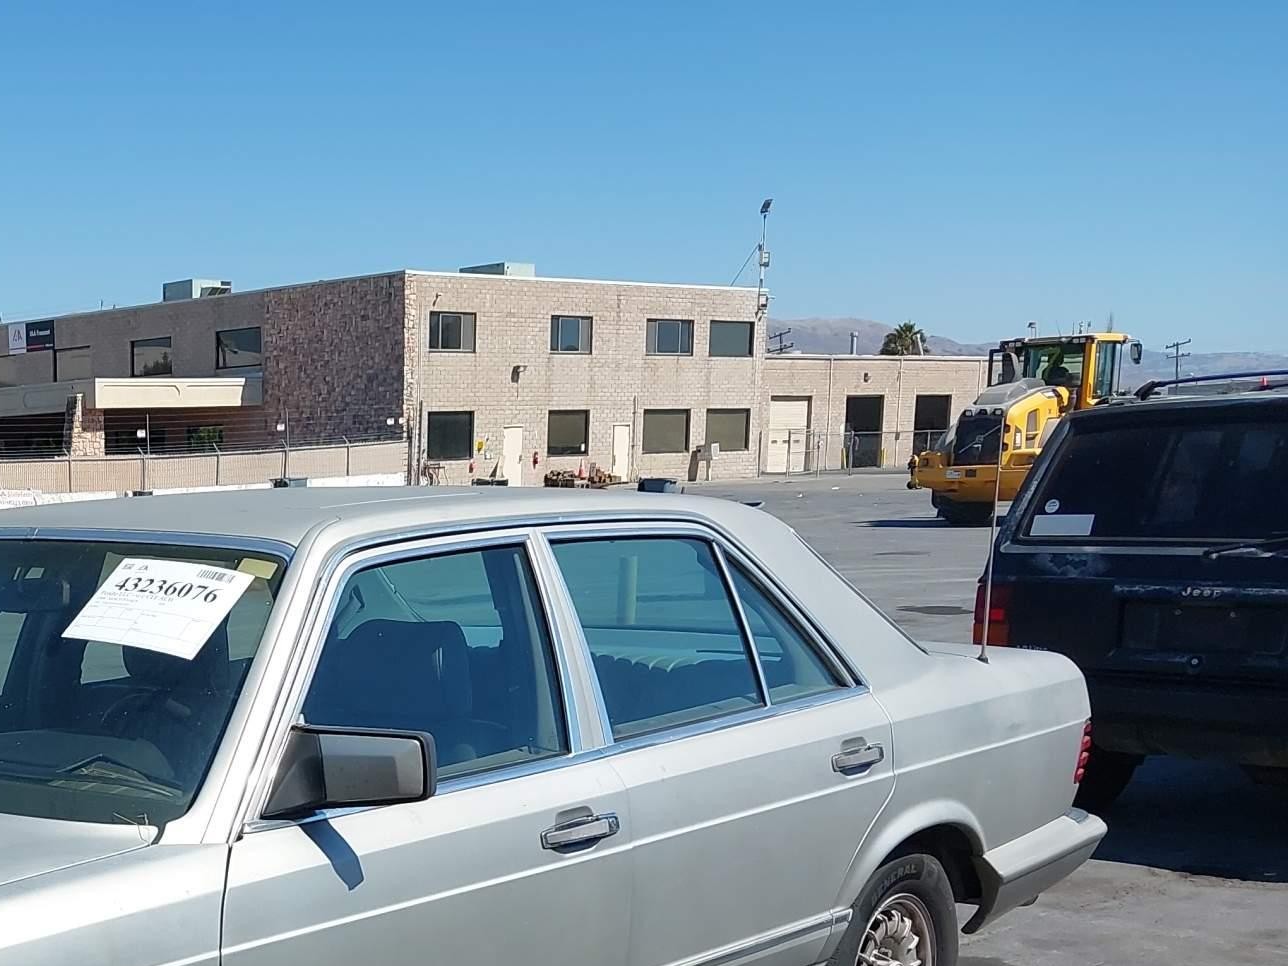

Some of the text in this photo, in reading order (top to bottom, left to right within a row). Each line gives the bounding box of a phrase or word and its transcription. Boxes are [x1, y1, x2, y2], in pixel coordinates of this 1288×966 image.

[114, 576, 226, 604] 43236076
[1181, 586, 1224, 599] Jeep
[871, 864, 918, 904] GENERAL
